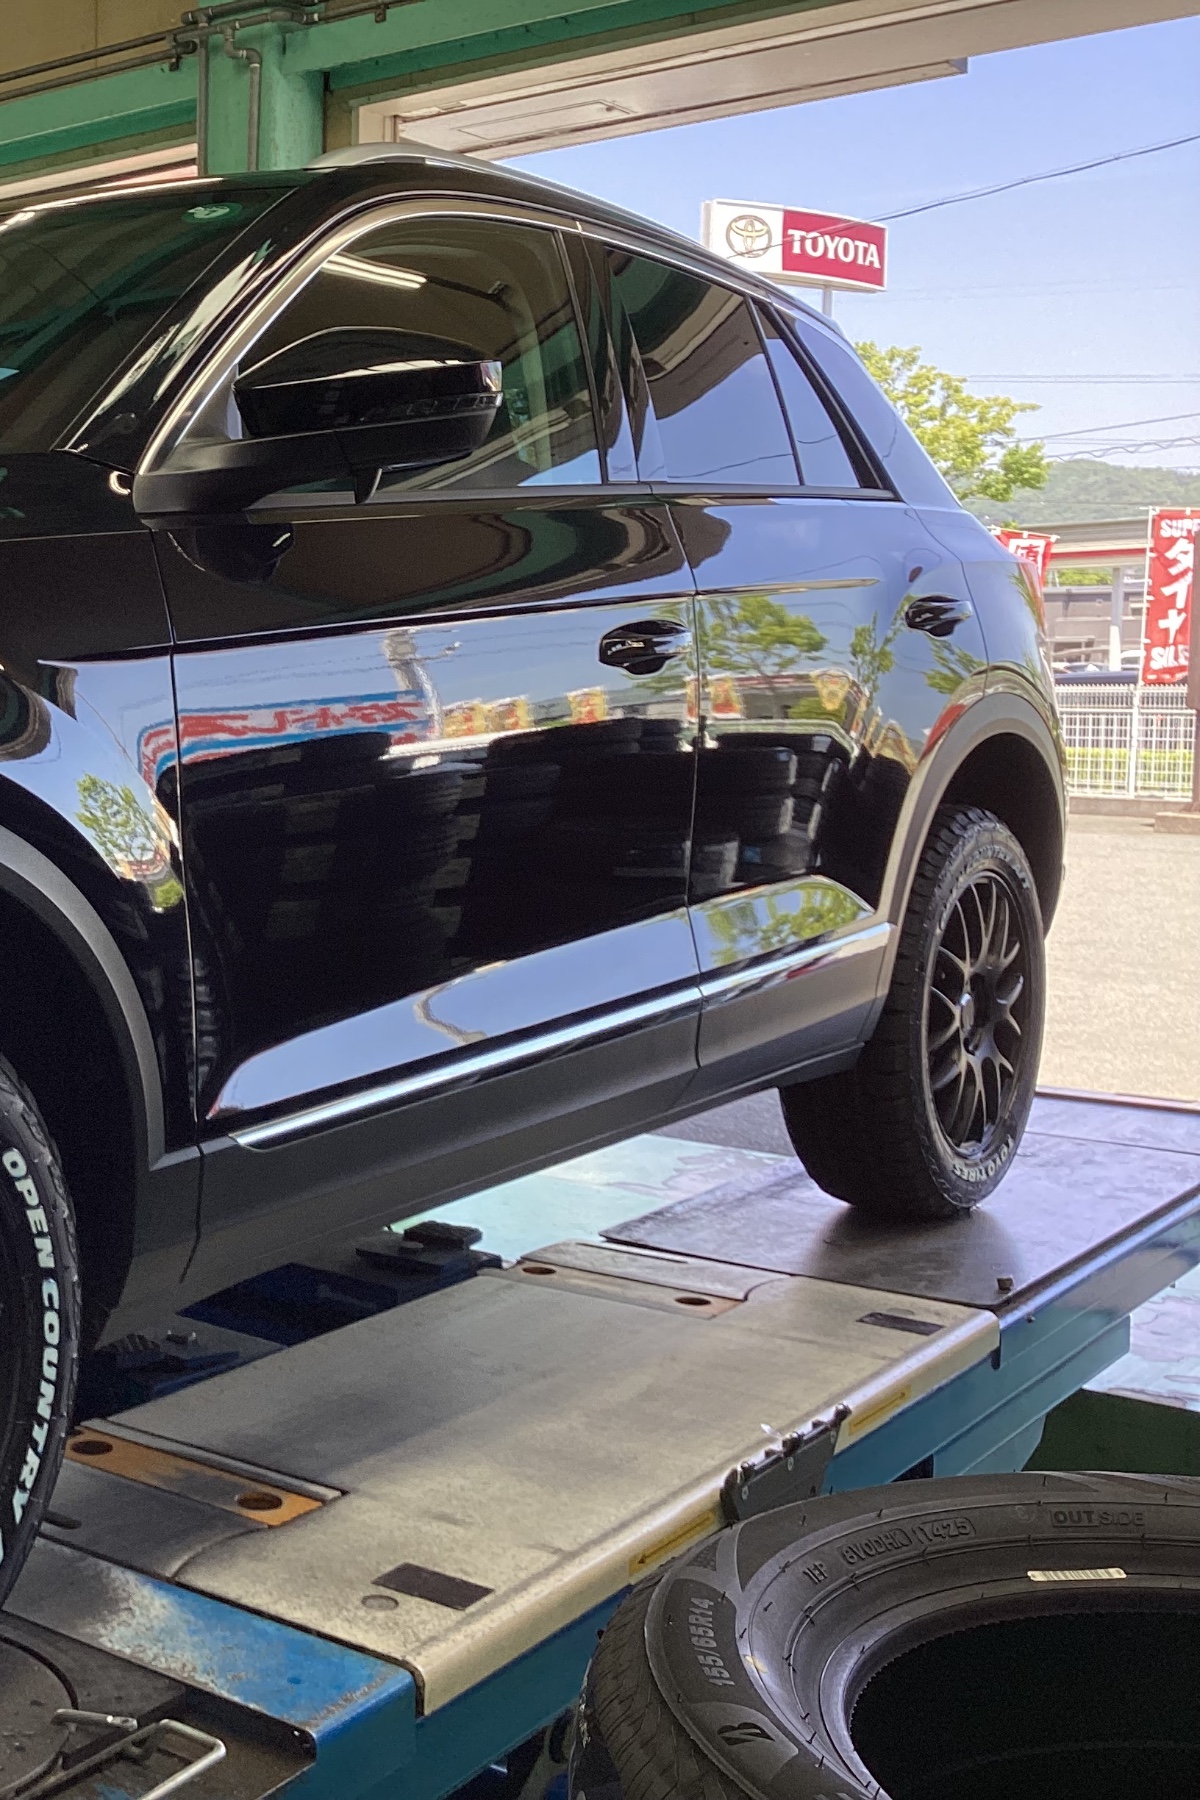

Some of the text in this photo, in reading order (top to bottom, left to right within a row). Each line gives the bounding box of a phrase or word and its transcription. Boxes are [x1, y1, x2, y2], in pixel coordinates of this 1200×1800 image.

[787, 228, 881, 269] TOYOTA
[1, 1147, 56, 1269] OPEN
[12, 1277, 61, 1525] COUNTRY
[688, 1596, 736, 1687] 155/65R14
